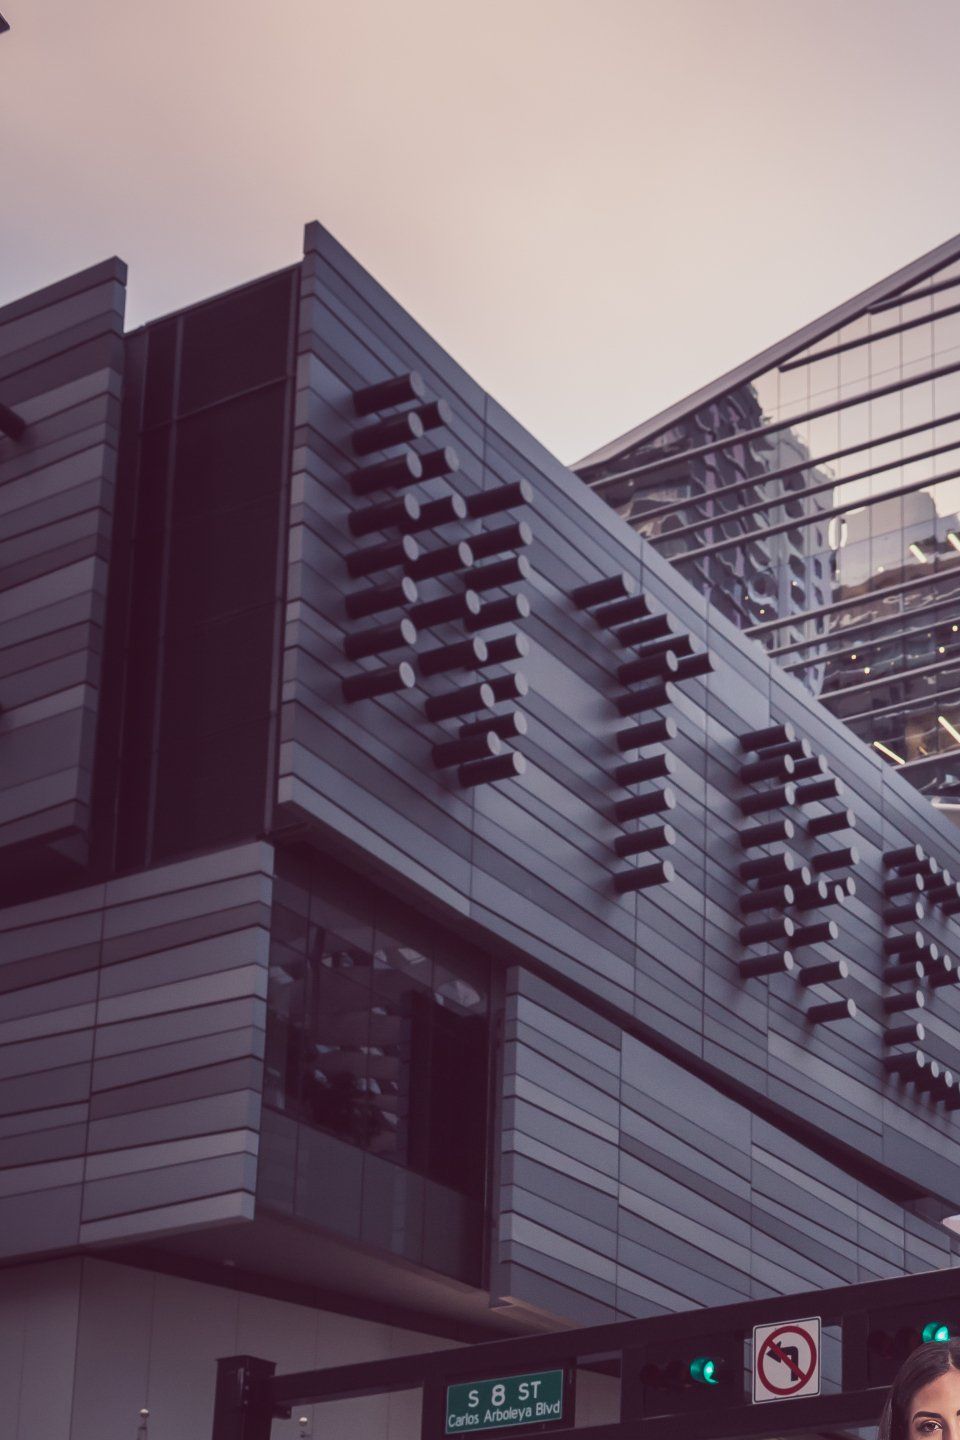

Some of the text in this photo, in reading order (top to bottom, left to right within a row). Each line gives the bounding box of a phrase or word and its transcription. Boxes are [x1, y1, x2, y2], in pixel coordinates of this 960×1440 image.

[468, 1380, 541, 1408] S 8 ST
[448, 1399, 560, 1428] Carlos Arboleya Blvd
